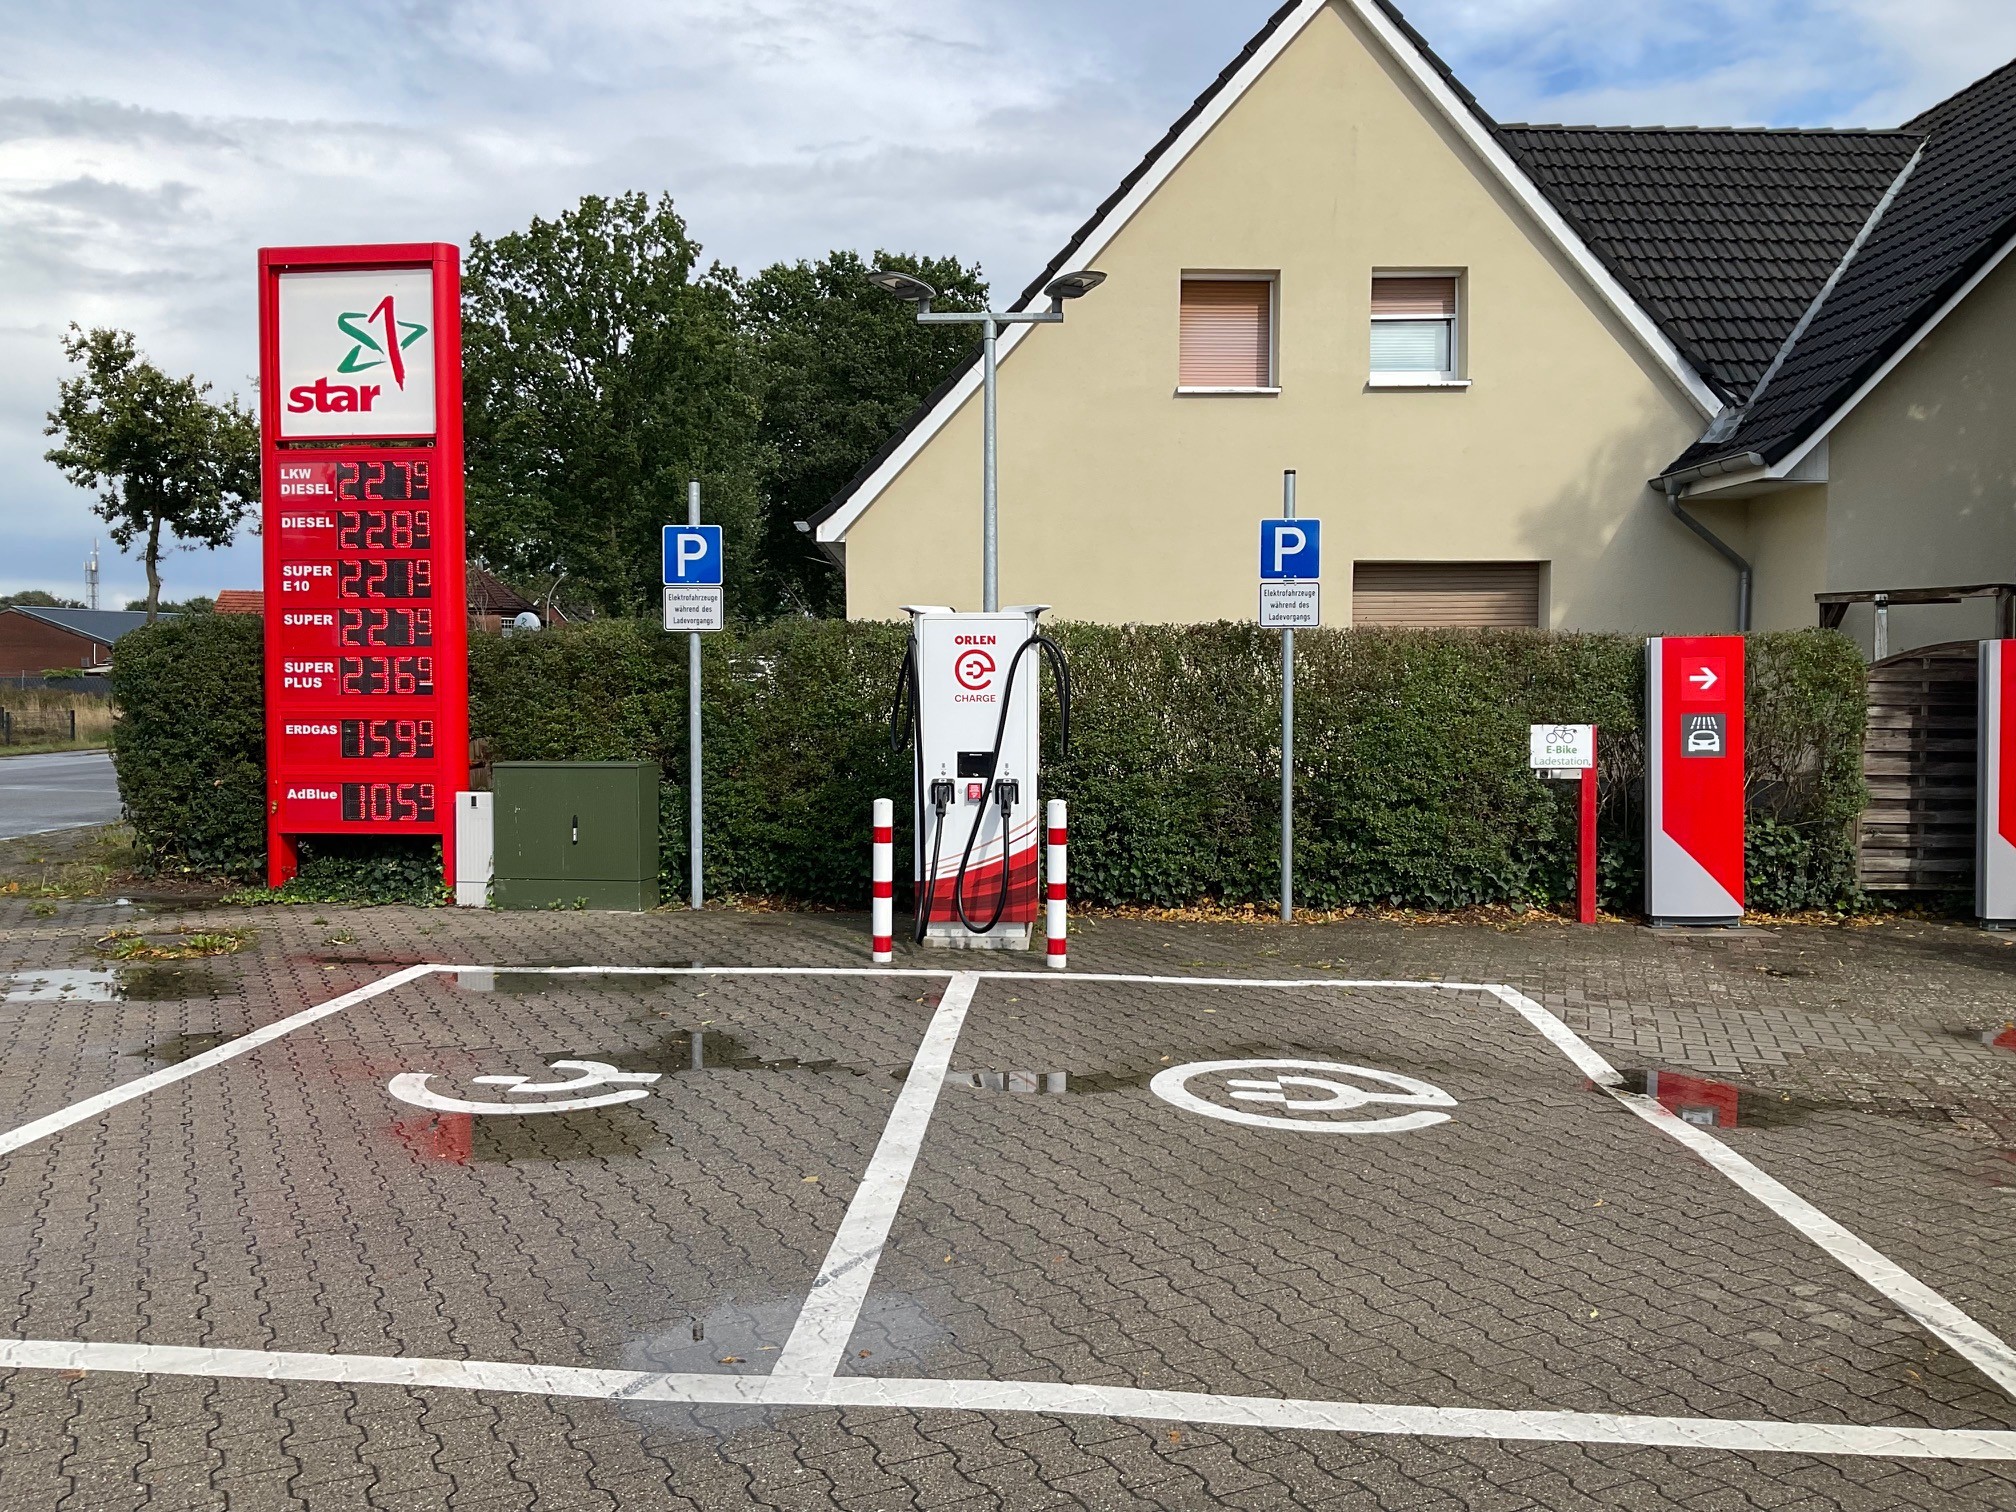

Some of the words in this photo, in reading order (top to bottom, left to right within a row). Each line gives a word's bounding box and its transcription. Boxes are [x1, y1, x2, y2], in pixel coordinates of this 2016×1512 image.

[287, 376, 380, 413] star
[280, 468, 311, 480] LKW
[281, 483, 333, 495] DIESEL
[281, 517, 334, 528] DIESEL
[340, 510, 430, 548] 2289
[1274, 526, 1307, 572] P
[677, 533, 708, 577] P
[282, 565, 333, 577] SUPER
[341, 559, 431, 598] 2219
[282, 581, 310, 592] E10
[668, 593, 718, 602] Elektrofahrzeuge
[1263, 589, 1316, 599] Elektrofahrzeuge
[674, 605, 700, 613] während
[701, 605, 713, 613] des
[1270, 601, 1296, 609] während
[1298, 601, 1310, 609] des
[283, 614, 334, 626] SUPER
[673, 616, 714, 626] Ladevorgangs
[1268, 613, 1311, 622] Ladevorgangs
[954, 635, 996, 645] ORLEN
[284, 662, 334, 673] SUPER
[343, 656, 433, 694] 2369
[284, 677, 323, 688] PLUS
[954, 694, 996, 703] CHARGE
[285, 725, 338, 735] ERDGAS
[1546, 745, 1578, 754] E-Bike
[1534, 757, 1590, 766] Ladestation
[287, 789, 338, 800] AdBlue
